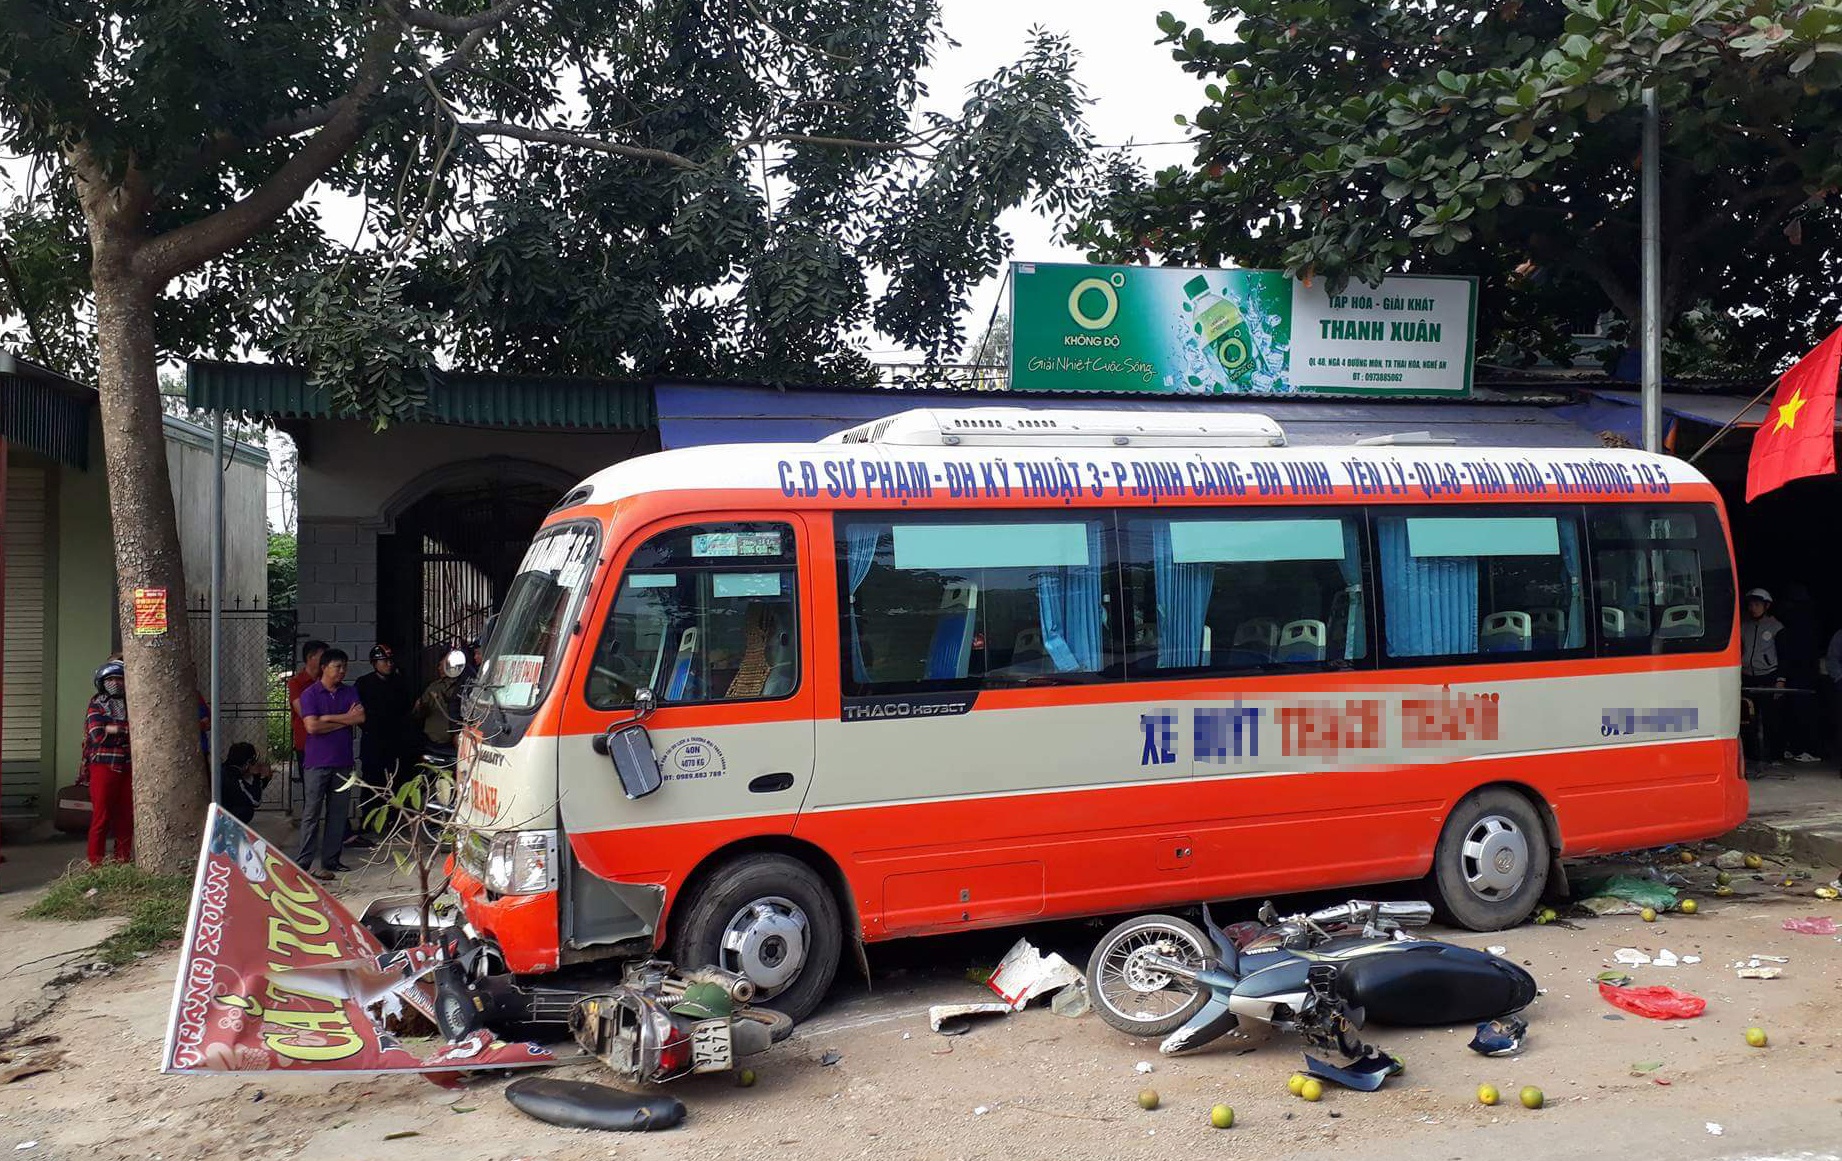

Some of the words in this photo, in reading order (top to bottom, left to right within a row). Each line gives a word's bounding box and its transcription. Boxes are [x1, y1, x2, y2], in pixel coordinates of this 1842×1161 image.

[1064, 334, 1101, 346] KHÔNG
[1104, 334, 1120, 348] ĐỘ
[1319, 319, 1385, 341] THANH
[1390, 318, 1442, 342] XUÂN
[1028, 356, 1055, 372] Giải
[1056, 357, 1093, 374] Nhiệt
[1092, 358, 1124, 374] Cuộc
[1123, 357, 1158, 382] Sống
[824, 457, 857, 498] SƯ
[862, 460, 932, 505] PHẠM
[979, 457, 1011, 498] KỸ
[1014, 456, 1084, 504] THUẬT
[1281, 462, 1334, 495] VINH
[1341, 457, 1385, 495] YÊN
[1632, 463, 1671, 494] 19.5
[843, 703, 910, 718] THACO
[250, 855, 342, 961] TÓC
[173, 957, 216, 1070] THANH
[196, 861, 231, 955] XUÂN
